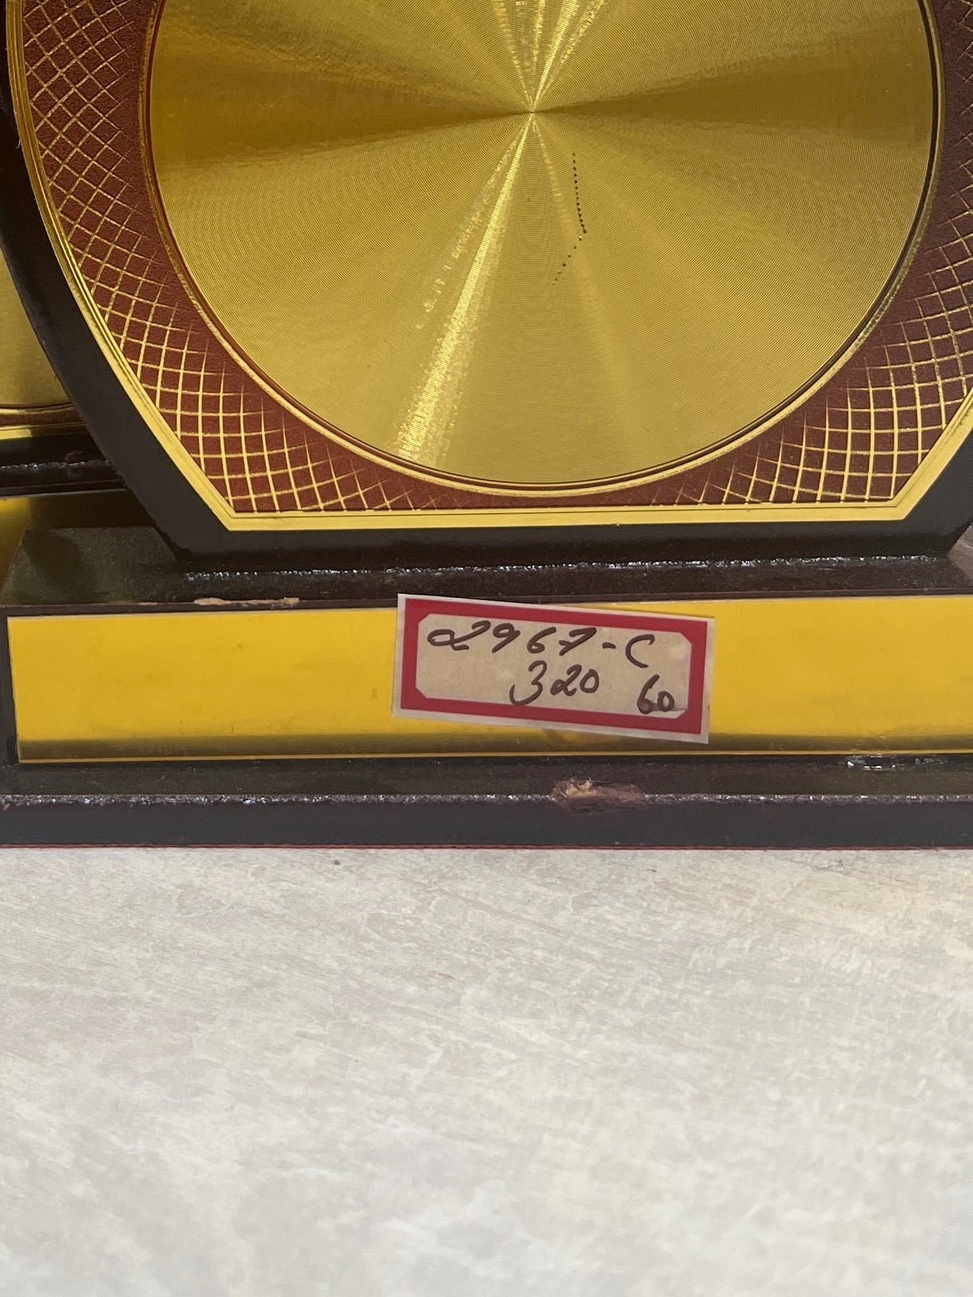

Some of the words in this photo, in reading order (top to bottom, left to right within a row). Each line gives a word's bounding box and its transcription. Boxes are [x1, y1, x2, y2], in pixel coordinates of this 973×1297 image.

[427, 620, 656, 668] 2967-C
[509, 660, 600, 706] 320
[637, 674, 675, 715] 60
